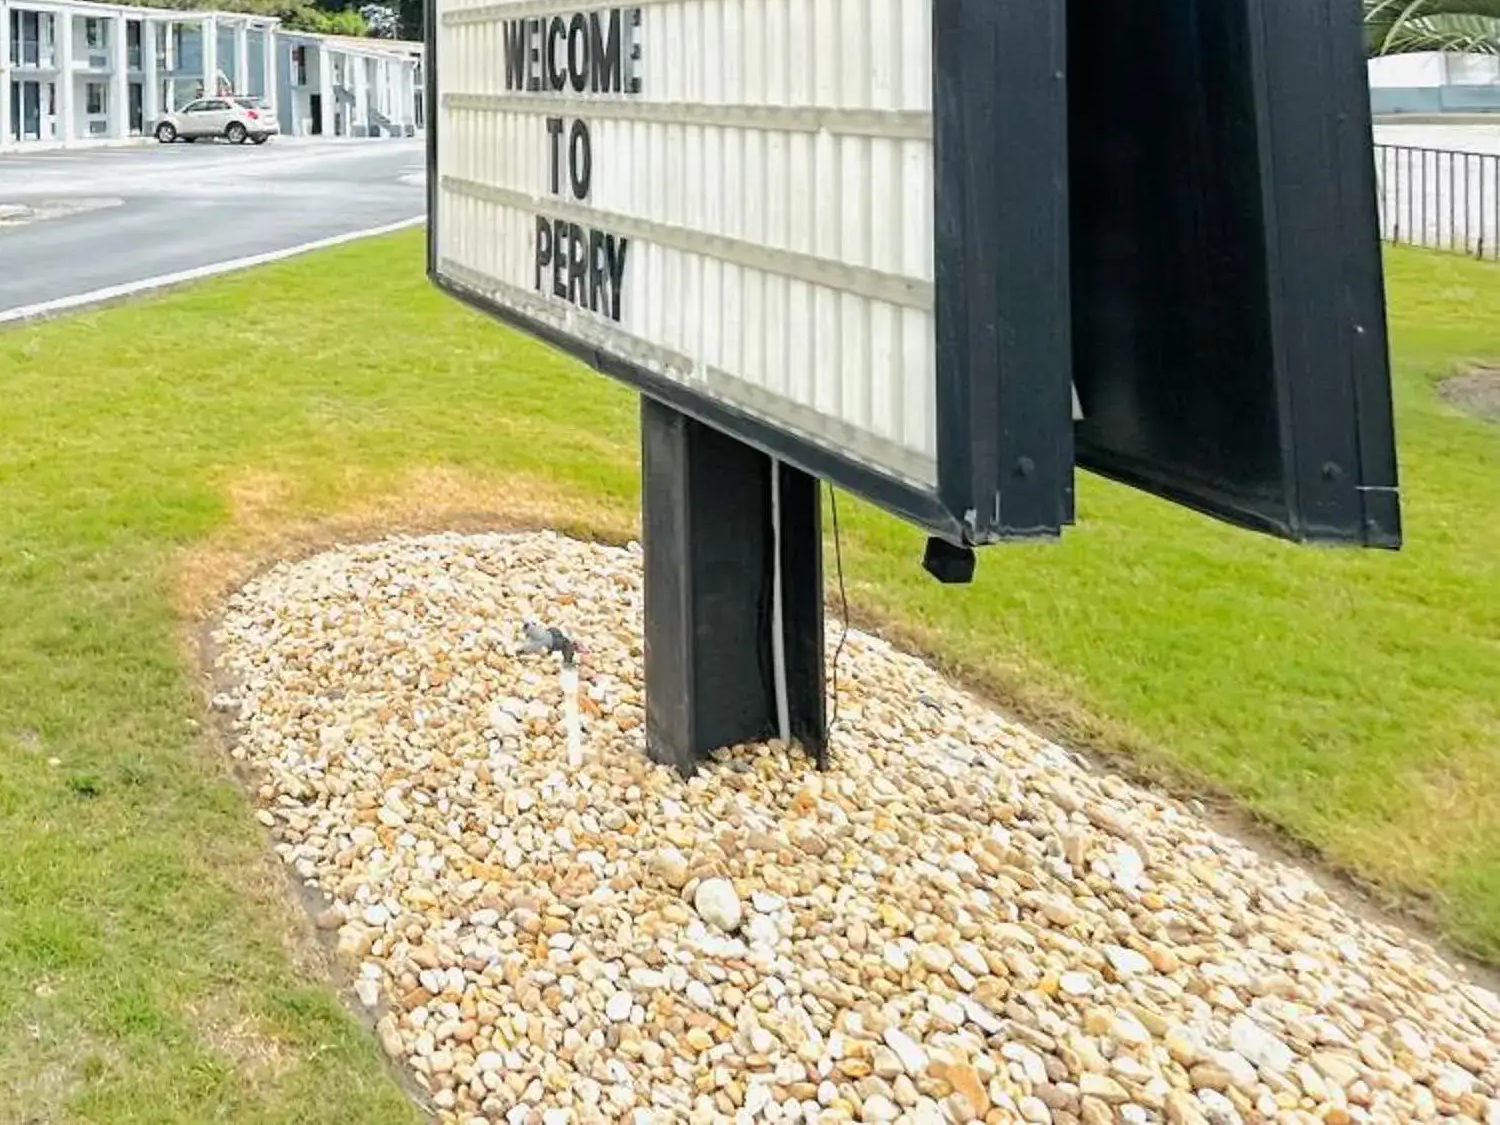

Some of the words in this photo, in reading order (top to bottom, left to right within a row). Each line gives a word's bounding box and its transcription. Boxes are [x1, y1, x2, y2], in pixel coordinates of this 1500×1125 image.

[503, 8, 641, 94] WELCOME
[546, 118, 592, 200] TO
[535, 215, 628, 322] PERRY
